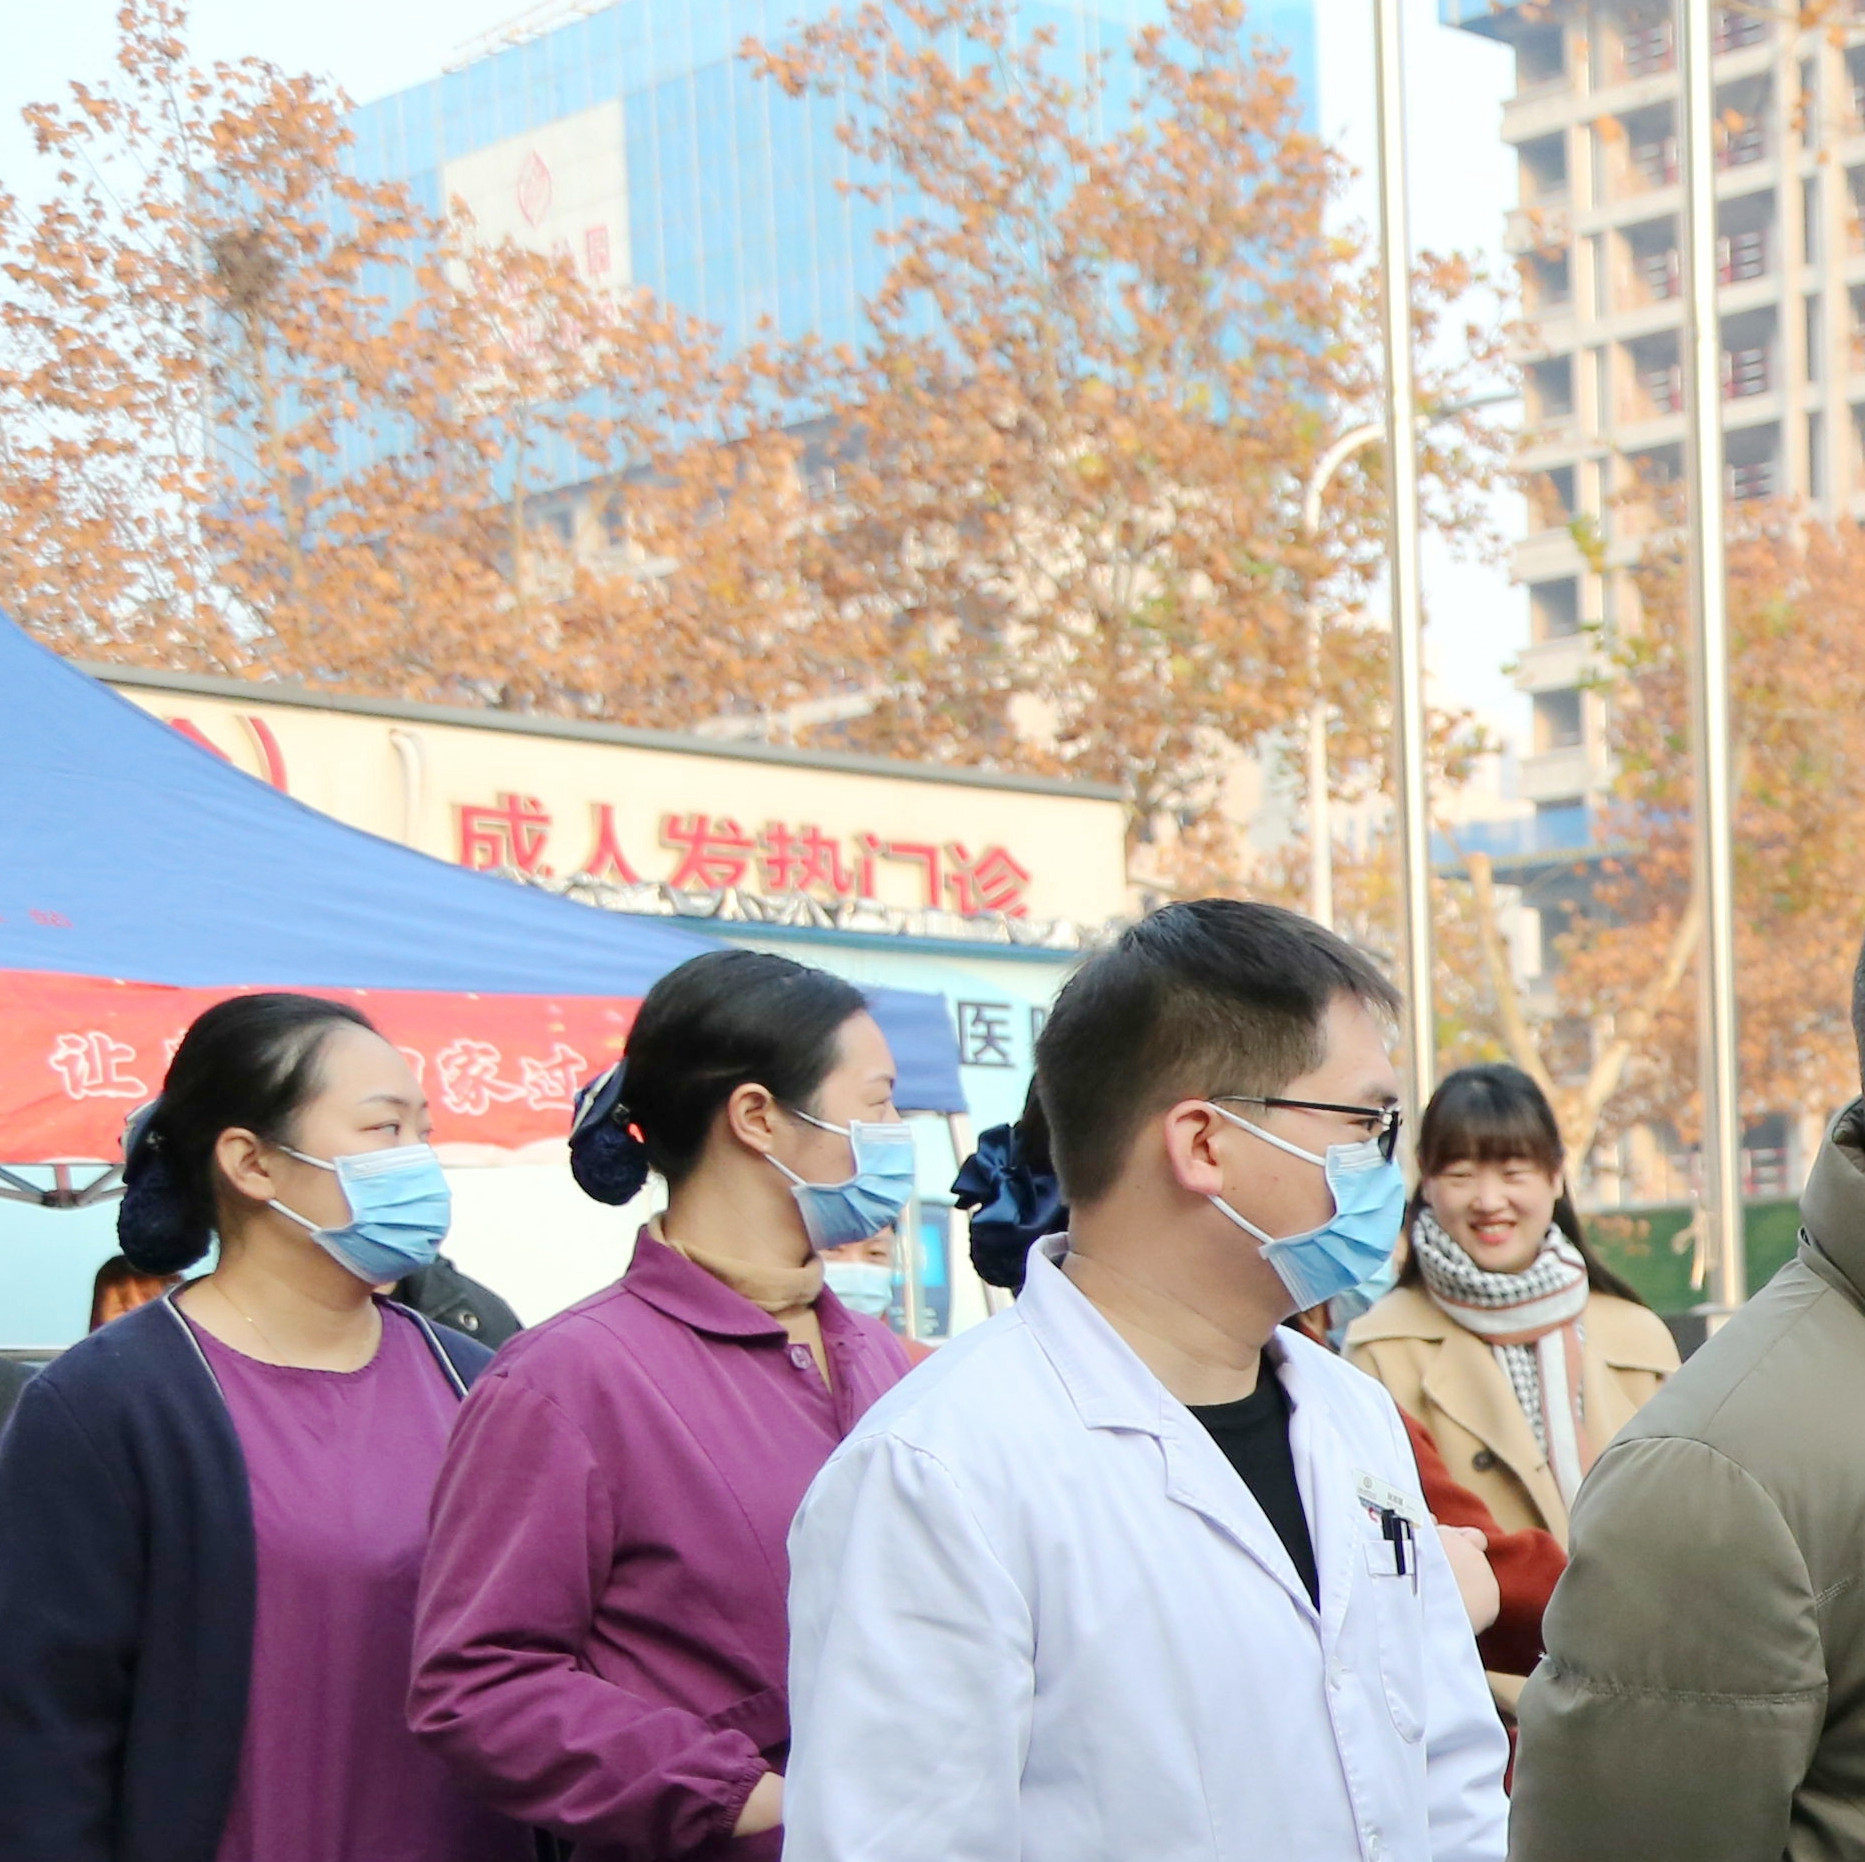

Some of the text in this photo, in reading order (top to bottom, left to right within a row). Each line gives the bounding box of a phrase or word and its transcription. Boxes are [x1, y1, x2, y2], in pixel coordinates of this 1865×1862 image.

[459, 793, 1032, 919] 成人发热门诊
